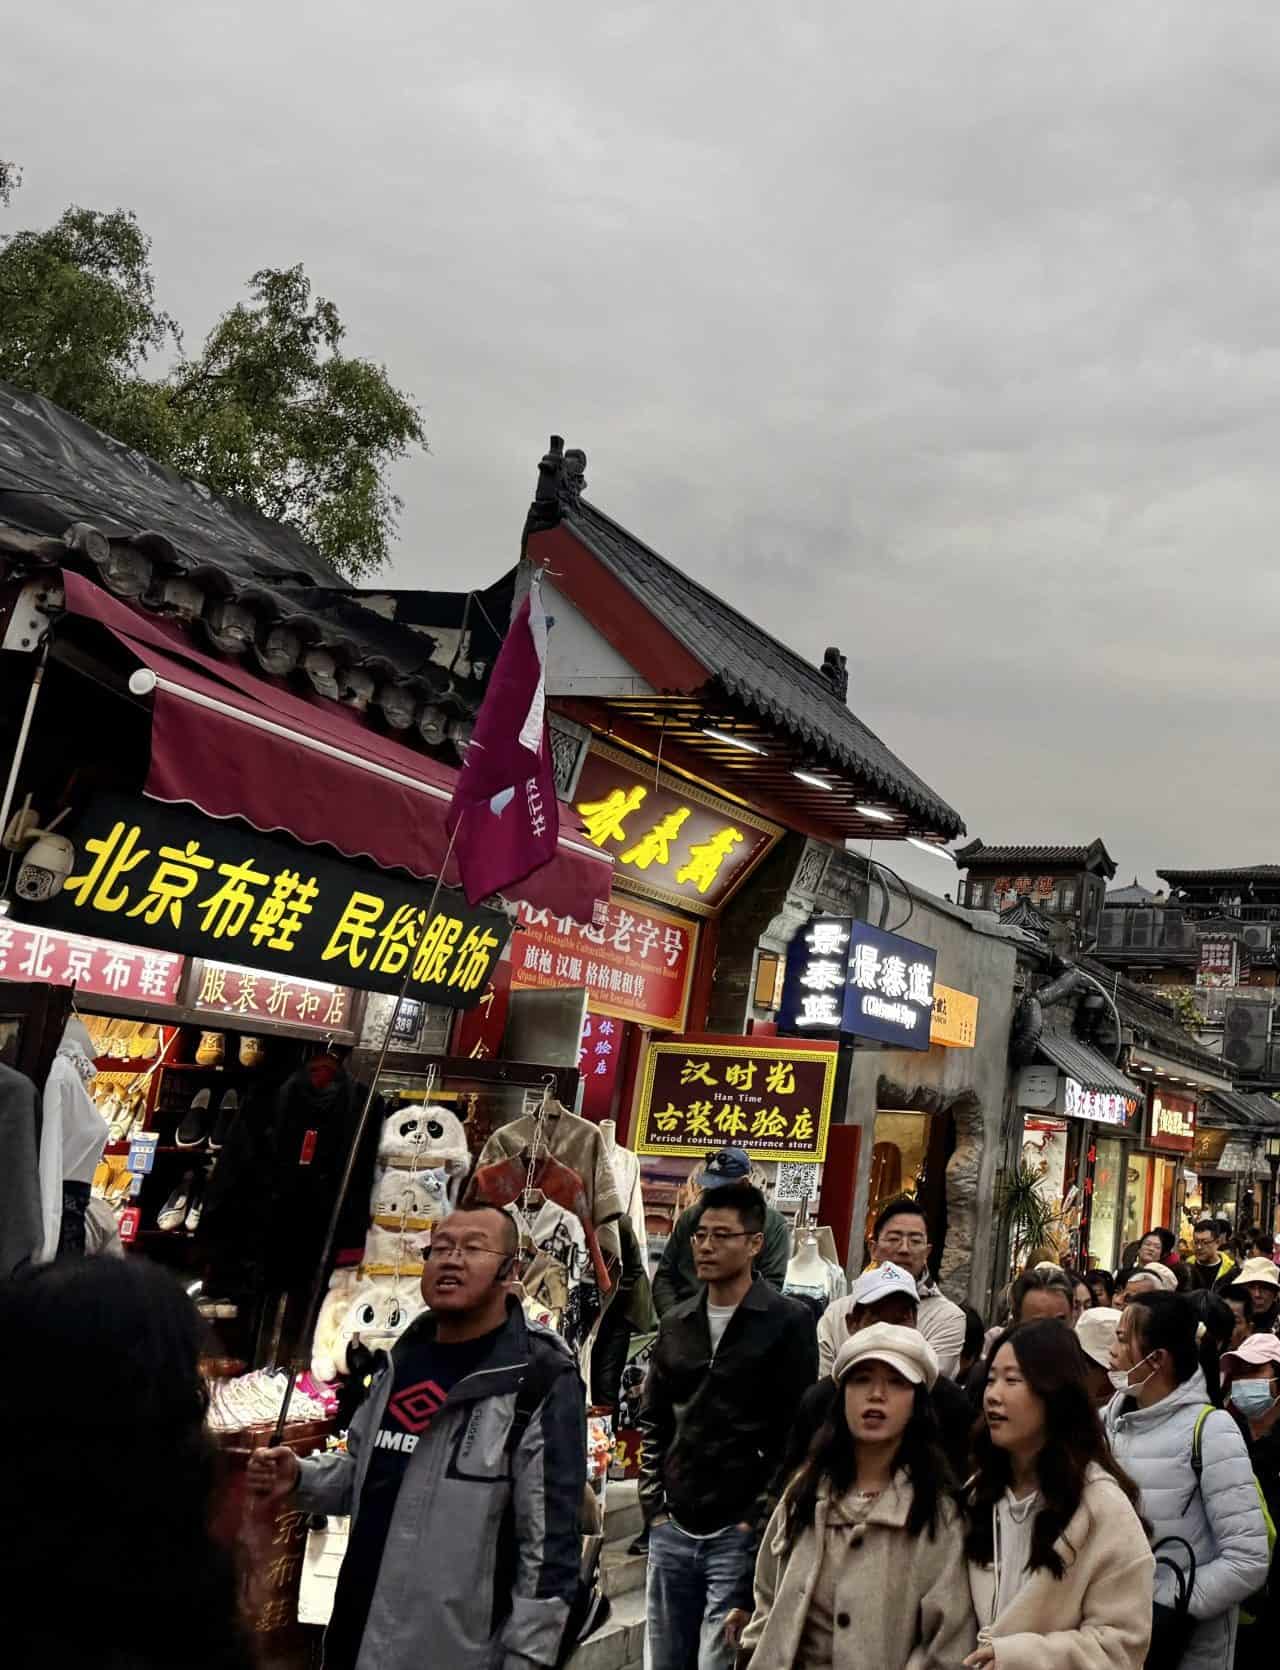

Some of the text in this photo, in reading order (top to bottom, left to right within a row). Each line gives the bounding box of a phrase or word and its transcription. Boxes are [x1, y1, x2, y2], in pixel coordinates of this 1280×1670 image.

[64, 821, 499, 993] 北京布鞋 民俗服饰
[198, 967, 345, 1025] 服装折扣店
[523, 944, 552, 974] 旗袍
[556, 952, 582, 981] 汉服
[586, 961, 645, 998] 格格服租售
[795, 924, 849, 1026] 景泰蓝
[593, 1020, 616, 1074] 体验店
[680, 1059, 796, 1094] 汉时光
[714, 1093, 762, 1103] Han Time
[650, 1133, 813, 1150] Period costume experience store
[653, 1101, 815, 1140] 古装体验店
